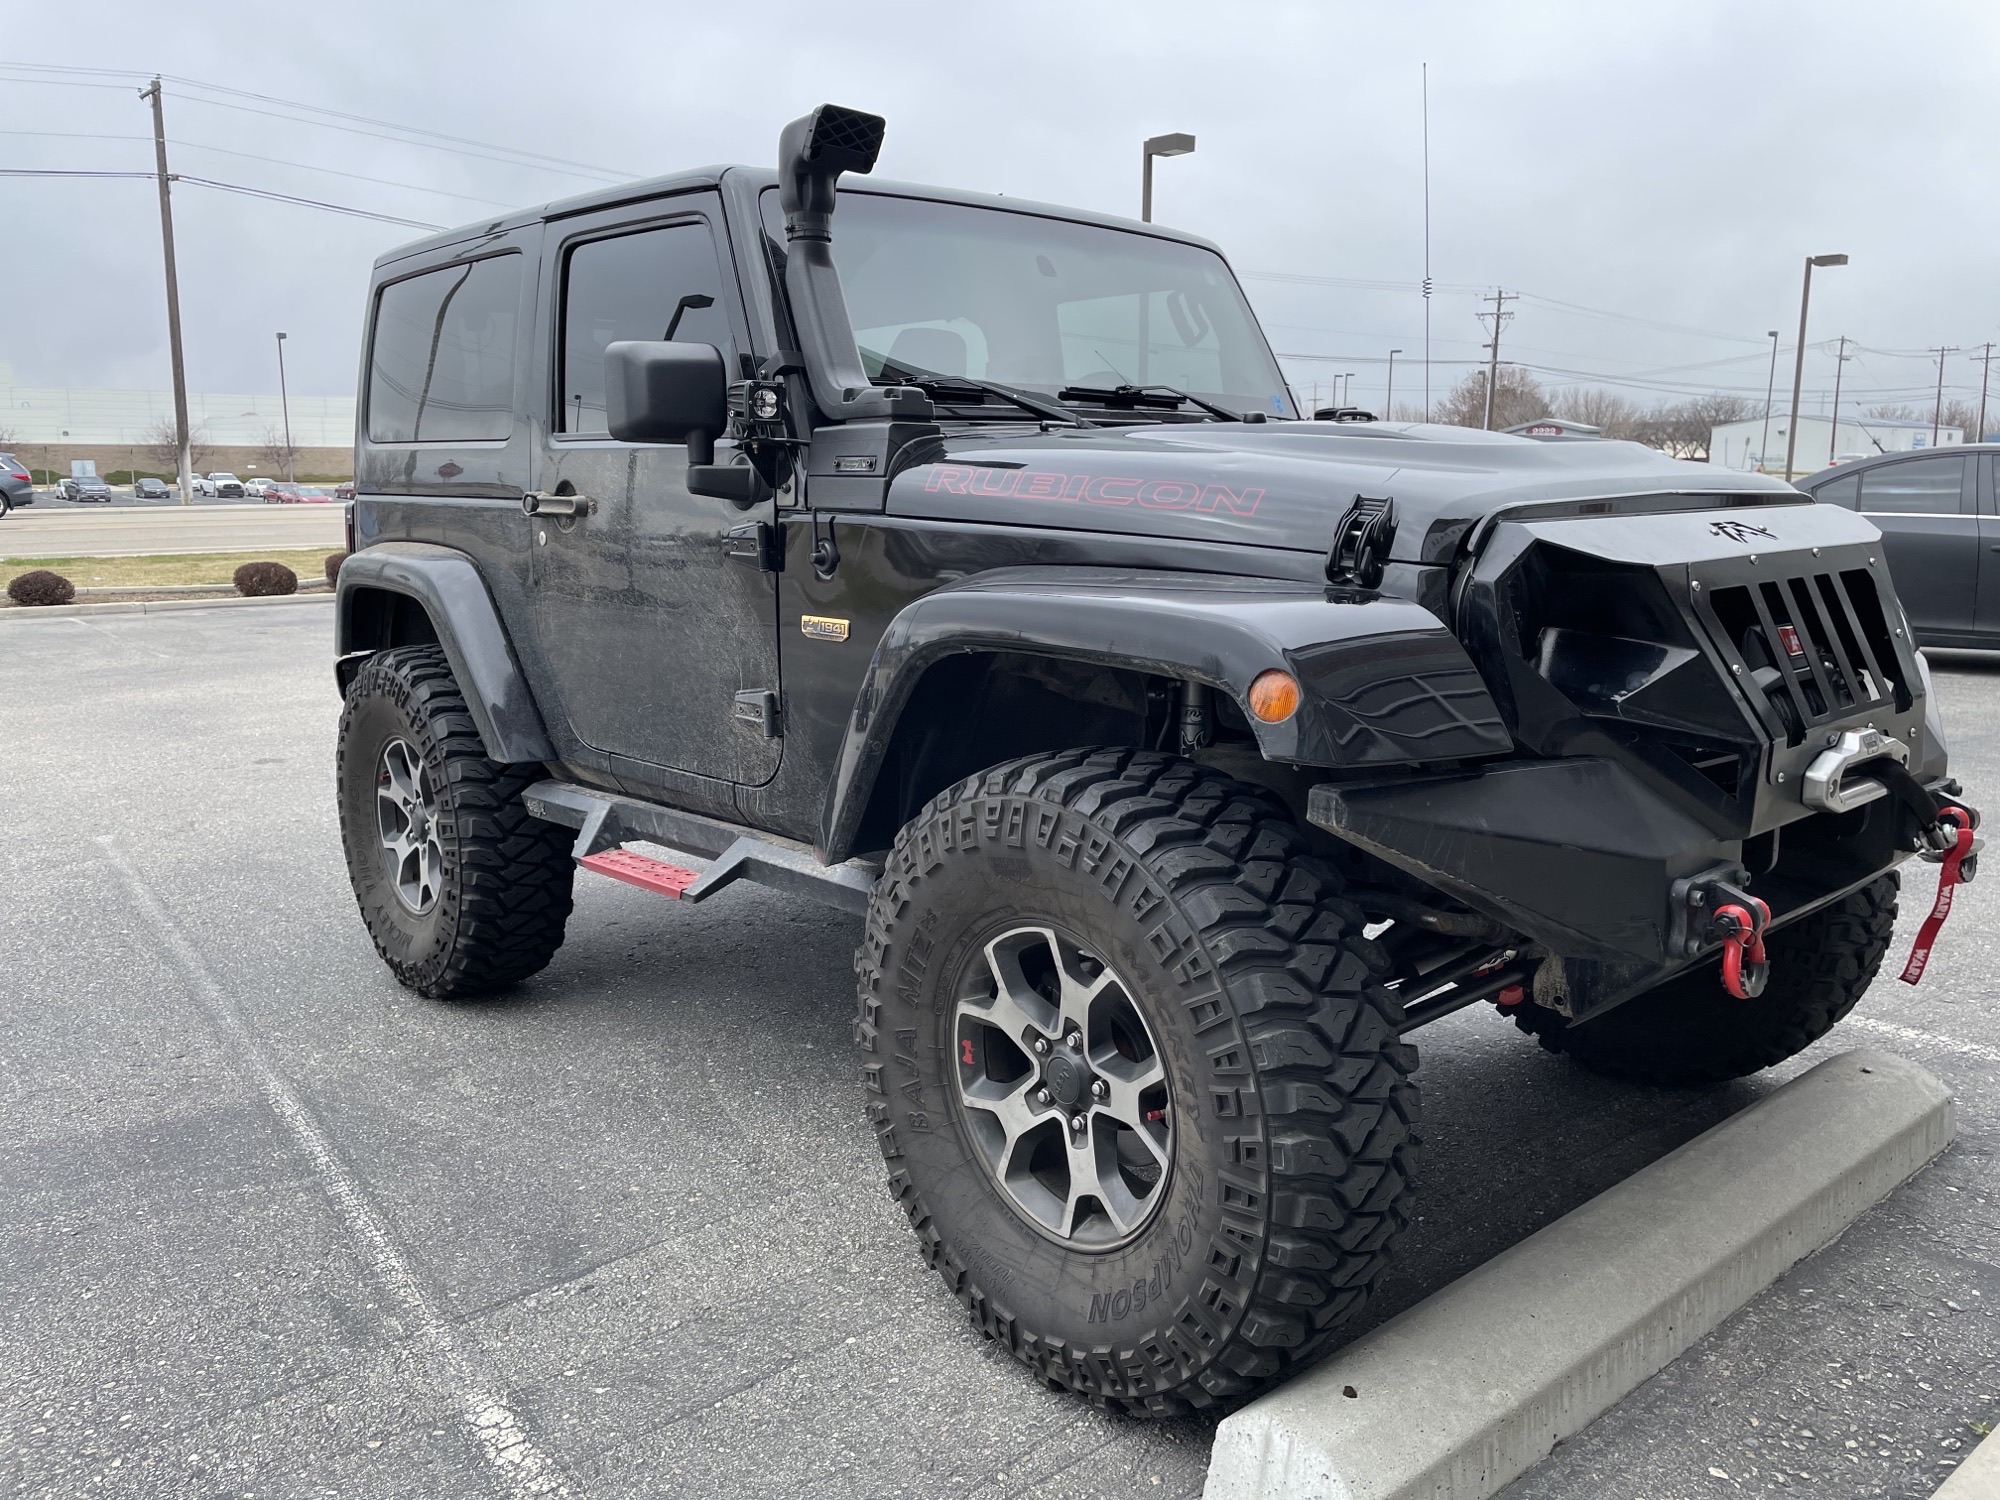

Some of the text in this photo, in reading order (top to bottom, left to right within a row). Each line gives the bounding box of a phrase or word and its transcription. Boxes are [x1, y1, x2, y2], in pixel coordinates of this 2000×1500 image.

[924, 464, 1266, 516] RUBICON
[820, 622, 845, 634] 1941
[373, 904, 414, 950] MICKEY
[1932, 885, 1953, 920] WARN
[897, 925, 936, 1009] MTZ
[1904, 949, 1928, 982] WARN
[895, 1027, 933, 1134] BAJA
[1086, 946, 1204, 1325] MICKEY THOMPSON
